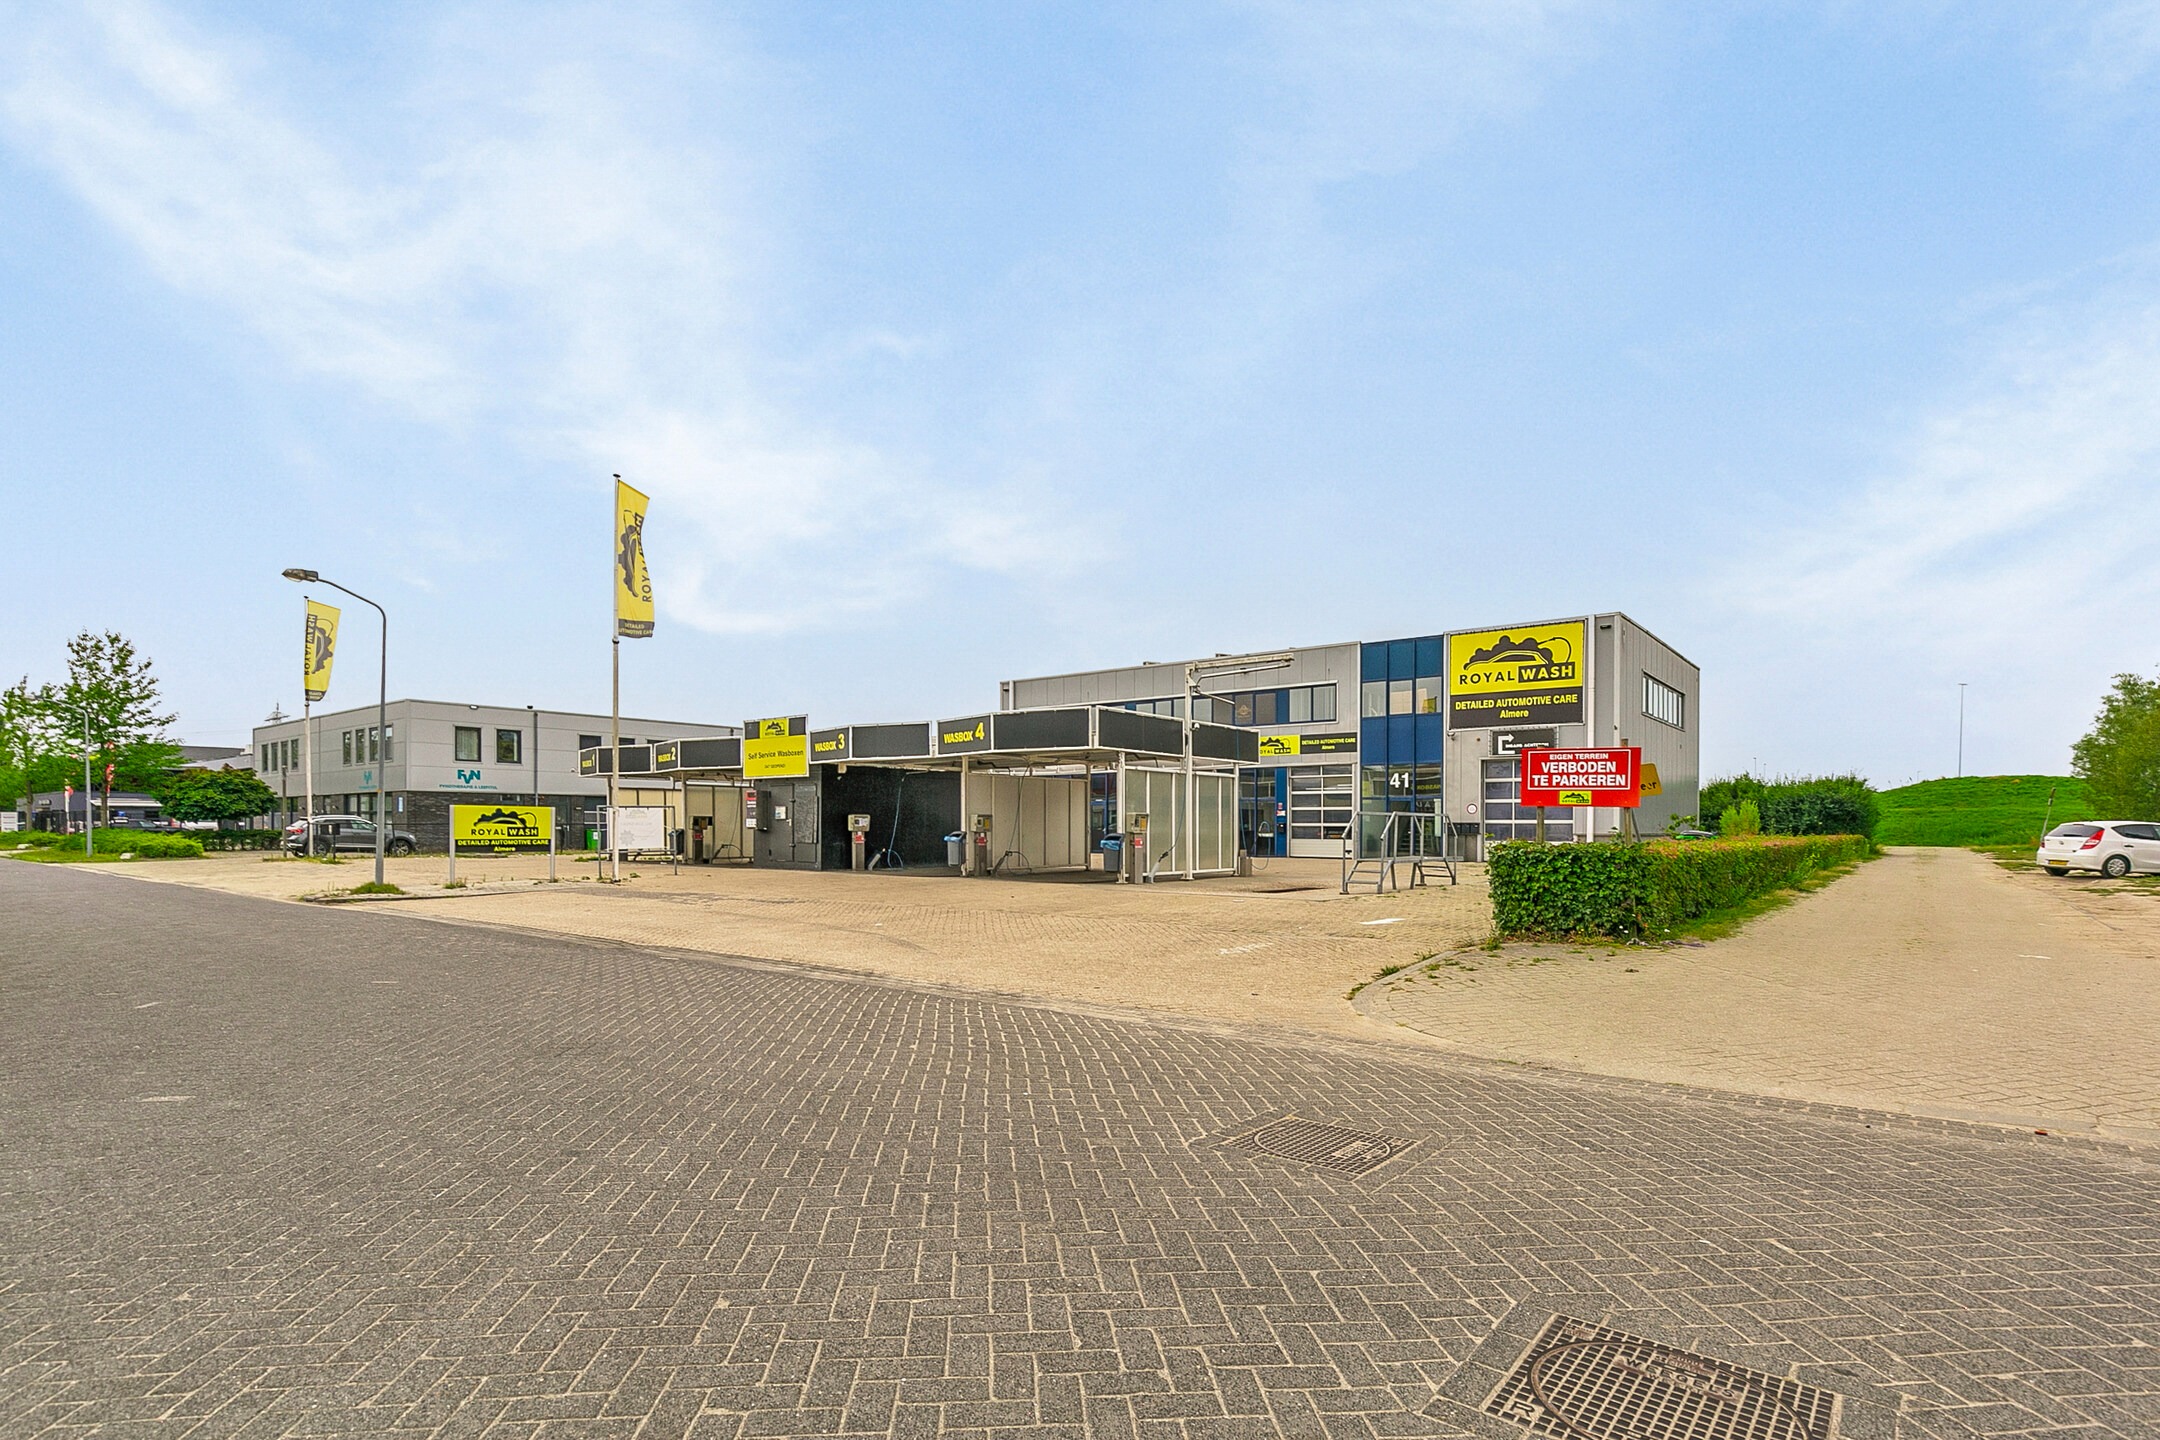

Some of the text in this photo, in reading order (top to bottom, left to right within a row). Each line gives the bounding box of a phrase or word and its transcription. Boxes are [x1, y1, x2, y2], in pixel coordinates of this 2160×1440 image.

[1459, 665, 1573, 685] ROYAL WASH
[1455, 694, 1578, 711] DETAILED AUTOMOTIVE CARE
[1499, 709, 1530, 719] Almere
[943, 722, 985, 744] WASBOX 4
[814, 733, 845, 752] WASBOX 3
[671, 746, 677, 761] 2
[758, 751, 776, 759] Service
[777, 749, 804, 757] Wasboxen
[1541, 761, 1617, 774] VERBODEN
[457, 769, 480, 784] FVN
[1389, 772, 1409, 788] 41
[1532, 774, 1626, 787] TE PARKEREN
[471, 828, 538, 836] ROYAL WASH
[1509, 1401, 1536, 1419] R
